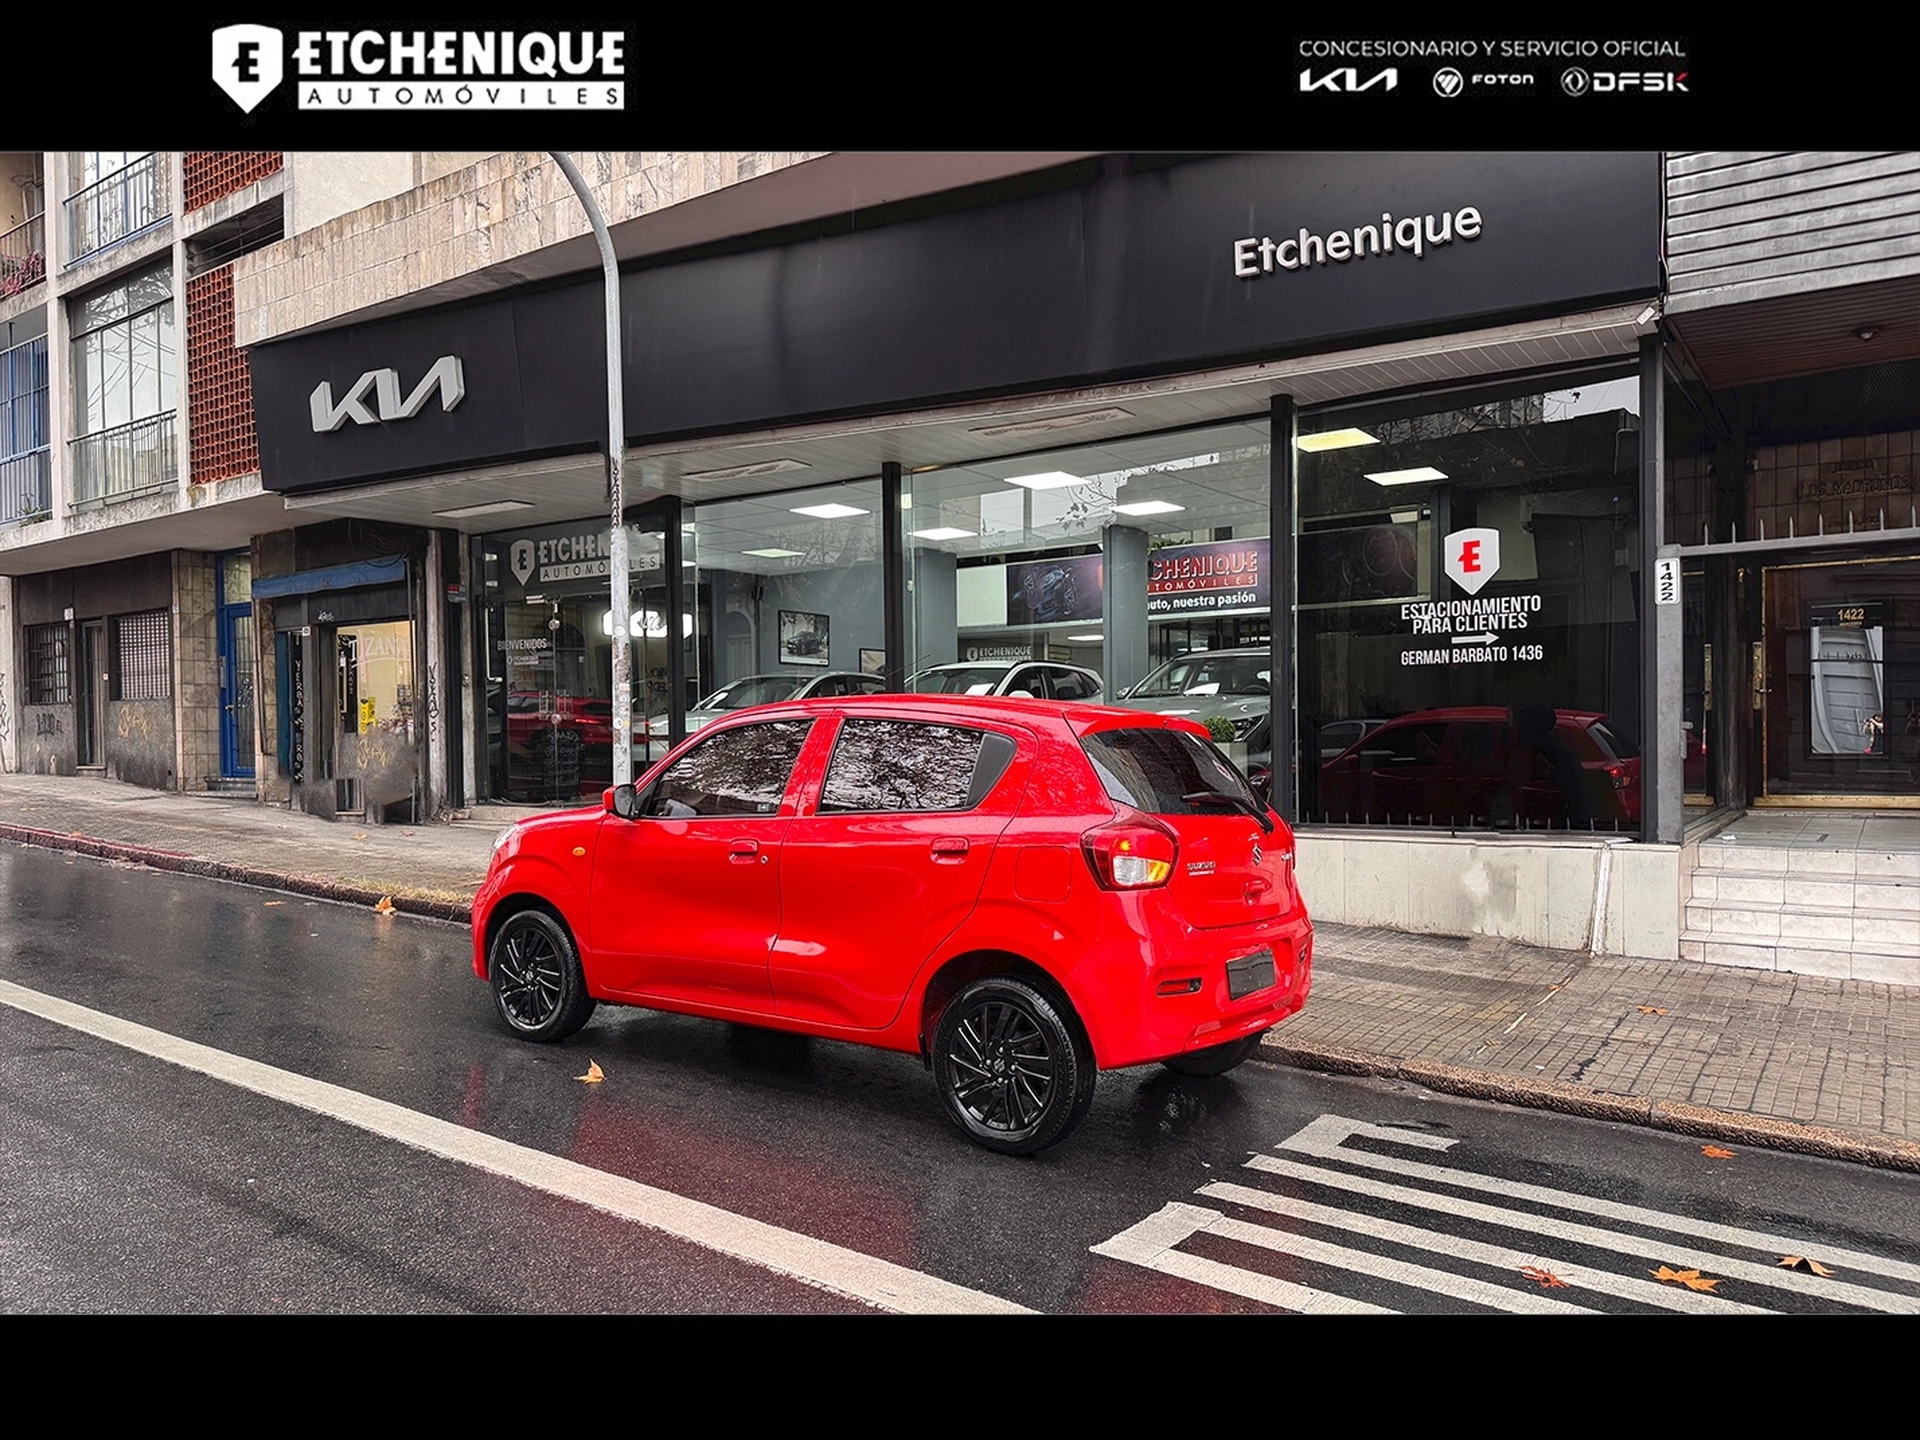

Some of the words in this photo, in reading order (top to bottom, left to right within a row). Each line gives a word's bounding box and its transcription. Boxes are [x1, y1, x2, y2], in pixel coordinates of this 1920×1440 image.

[1233, 206, 1483, 278] Etchenique
[309, 355, 466, 434] KIA
[542, 556, 657, 579] AUTOMÓLES
[1149, 550, 1258, 581] CHENIQUE
[1147, 575, 1254, 592] TOMÓVILES
[1660, 562, 1674, 602] 1422
[1173, 595, 1216, 608] nuestra
[1218, 591, 1256, 607] pasión
[1401, 595, 1542, 620] ESTACIONAMIENTO
[1413, 617, 1452, 635] PARA
[1456, 612, 1528, 632] CLIENTES
[1837, 608, 1865, 621] 1422
[497, 637, 548, 651] BIENVENIDOS
[1401, 649, 1450, 666] GERMAN
[1452, 646, 1508, 664] BARBATO
[1512, 644, 1544, 661] 1436
